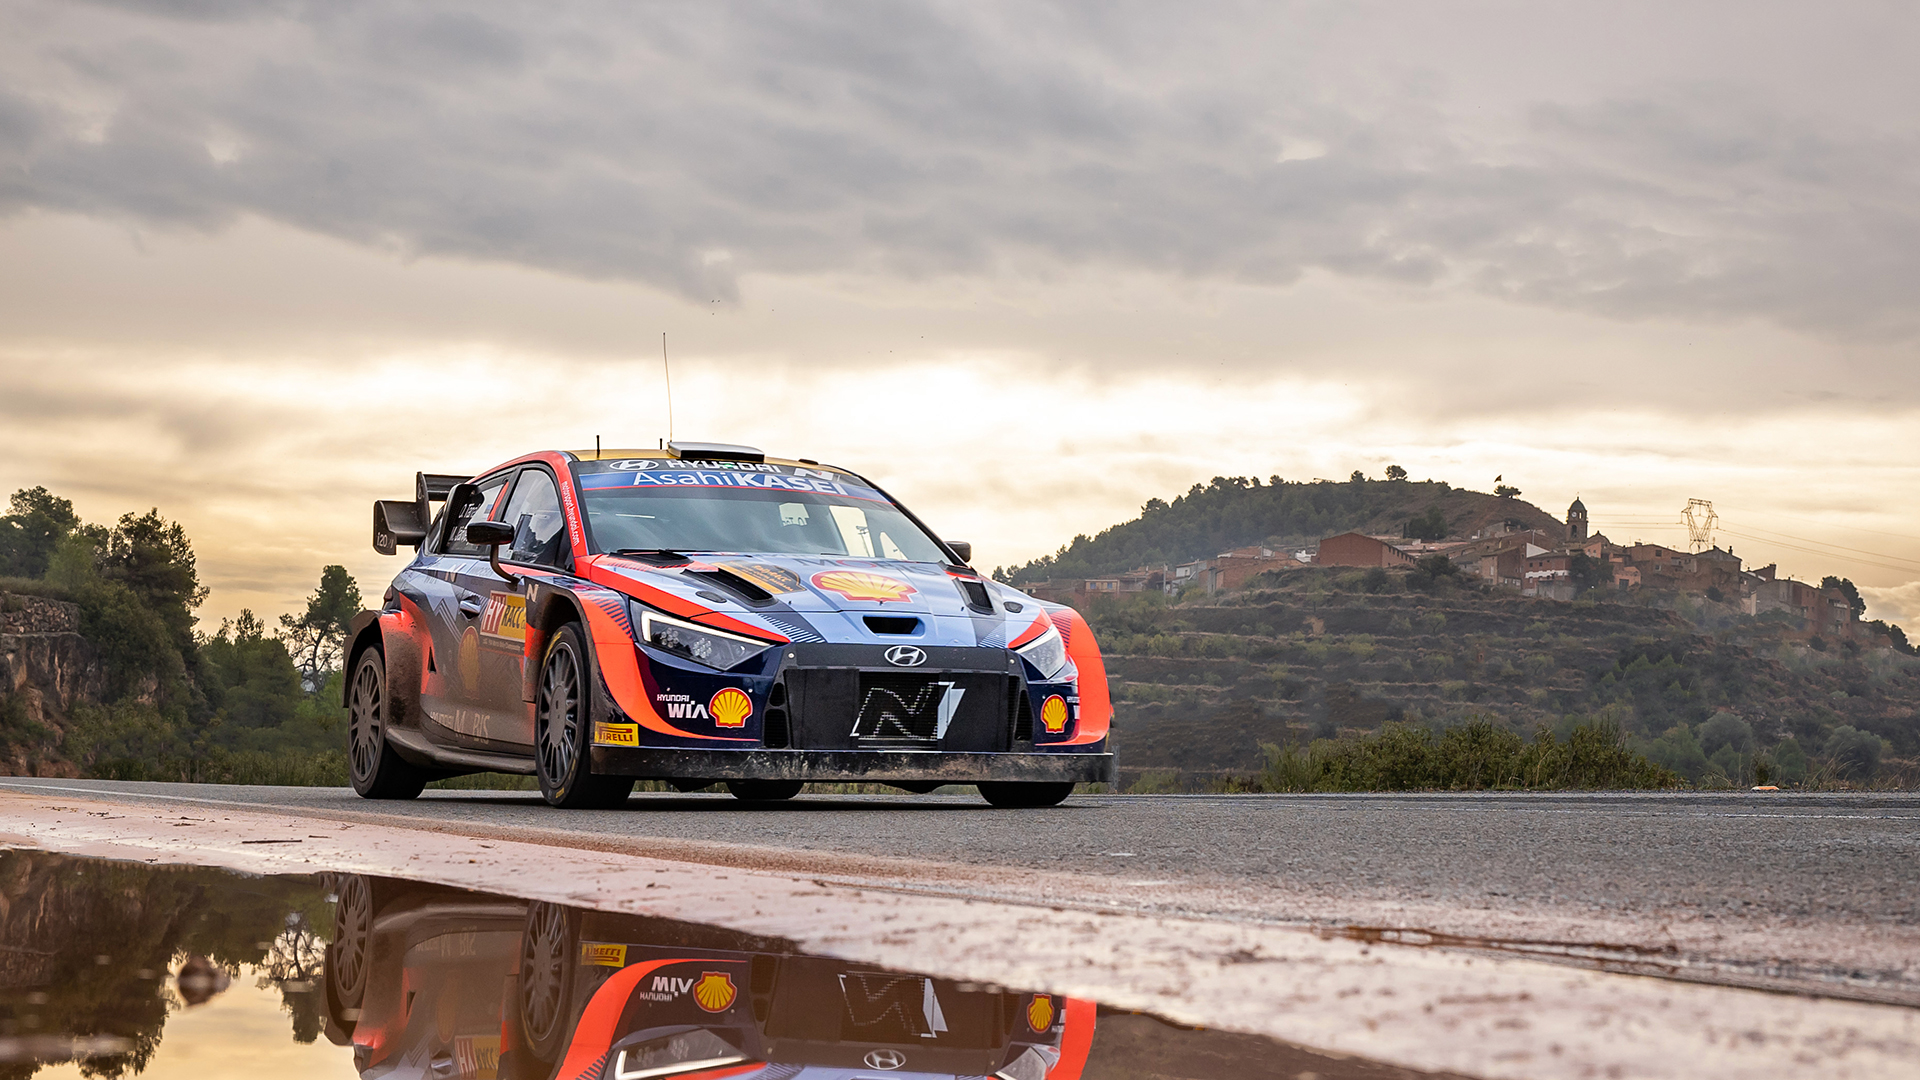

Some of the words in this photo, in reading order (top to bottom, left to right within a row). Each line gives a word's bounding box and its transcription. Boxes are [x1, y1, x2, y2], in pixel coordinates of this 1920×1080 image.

[633, 471, 849, 496] AsahiKASEI
[526, 583, 540, 603] N
[657, 693, 690, 702] HYUNDAI
[598, 727, 634, 742] PIRELLI
